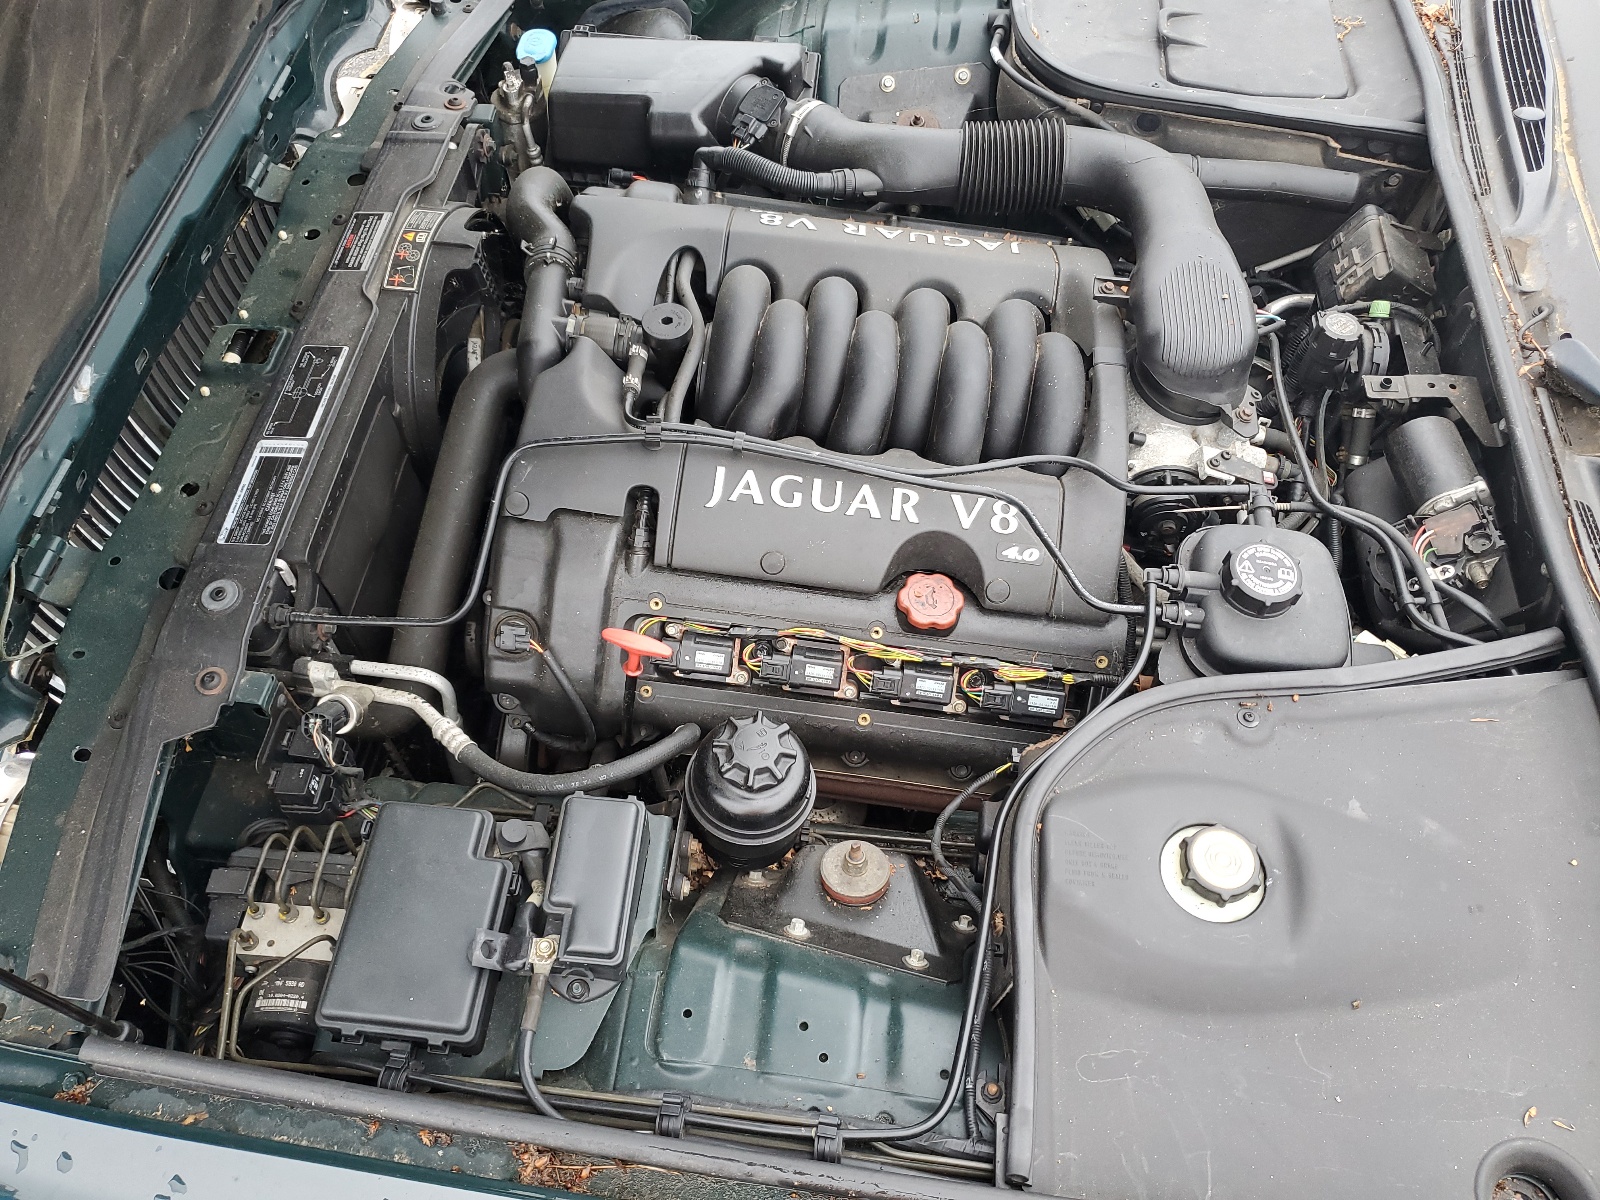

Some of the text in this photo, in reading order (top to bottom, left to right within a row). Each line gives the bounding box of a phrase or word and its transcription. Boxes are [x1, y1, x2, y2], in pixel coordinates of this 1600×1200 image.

[759, 213, 1021, 254] JAGUAR V8
[705, 466, 1018, 535] JAGUAR V8
[1000, 546, 1040, 562] 4.0
